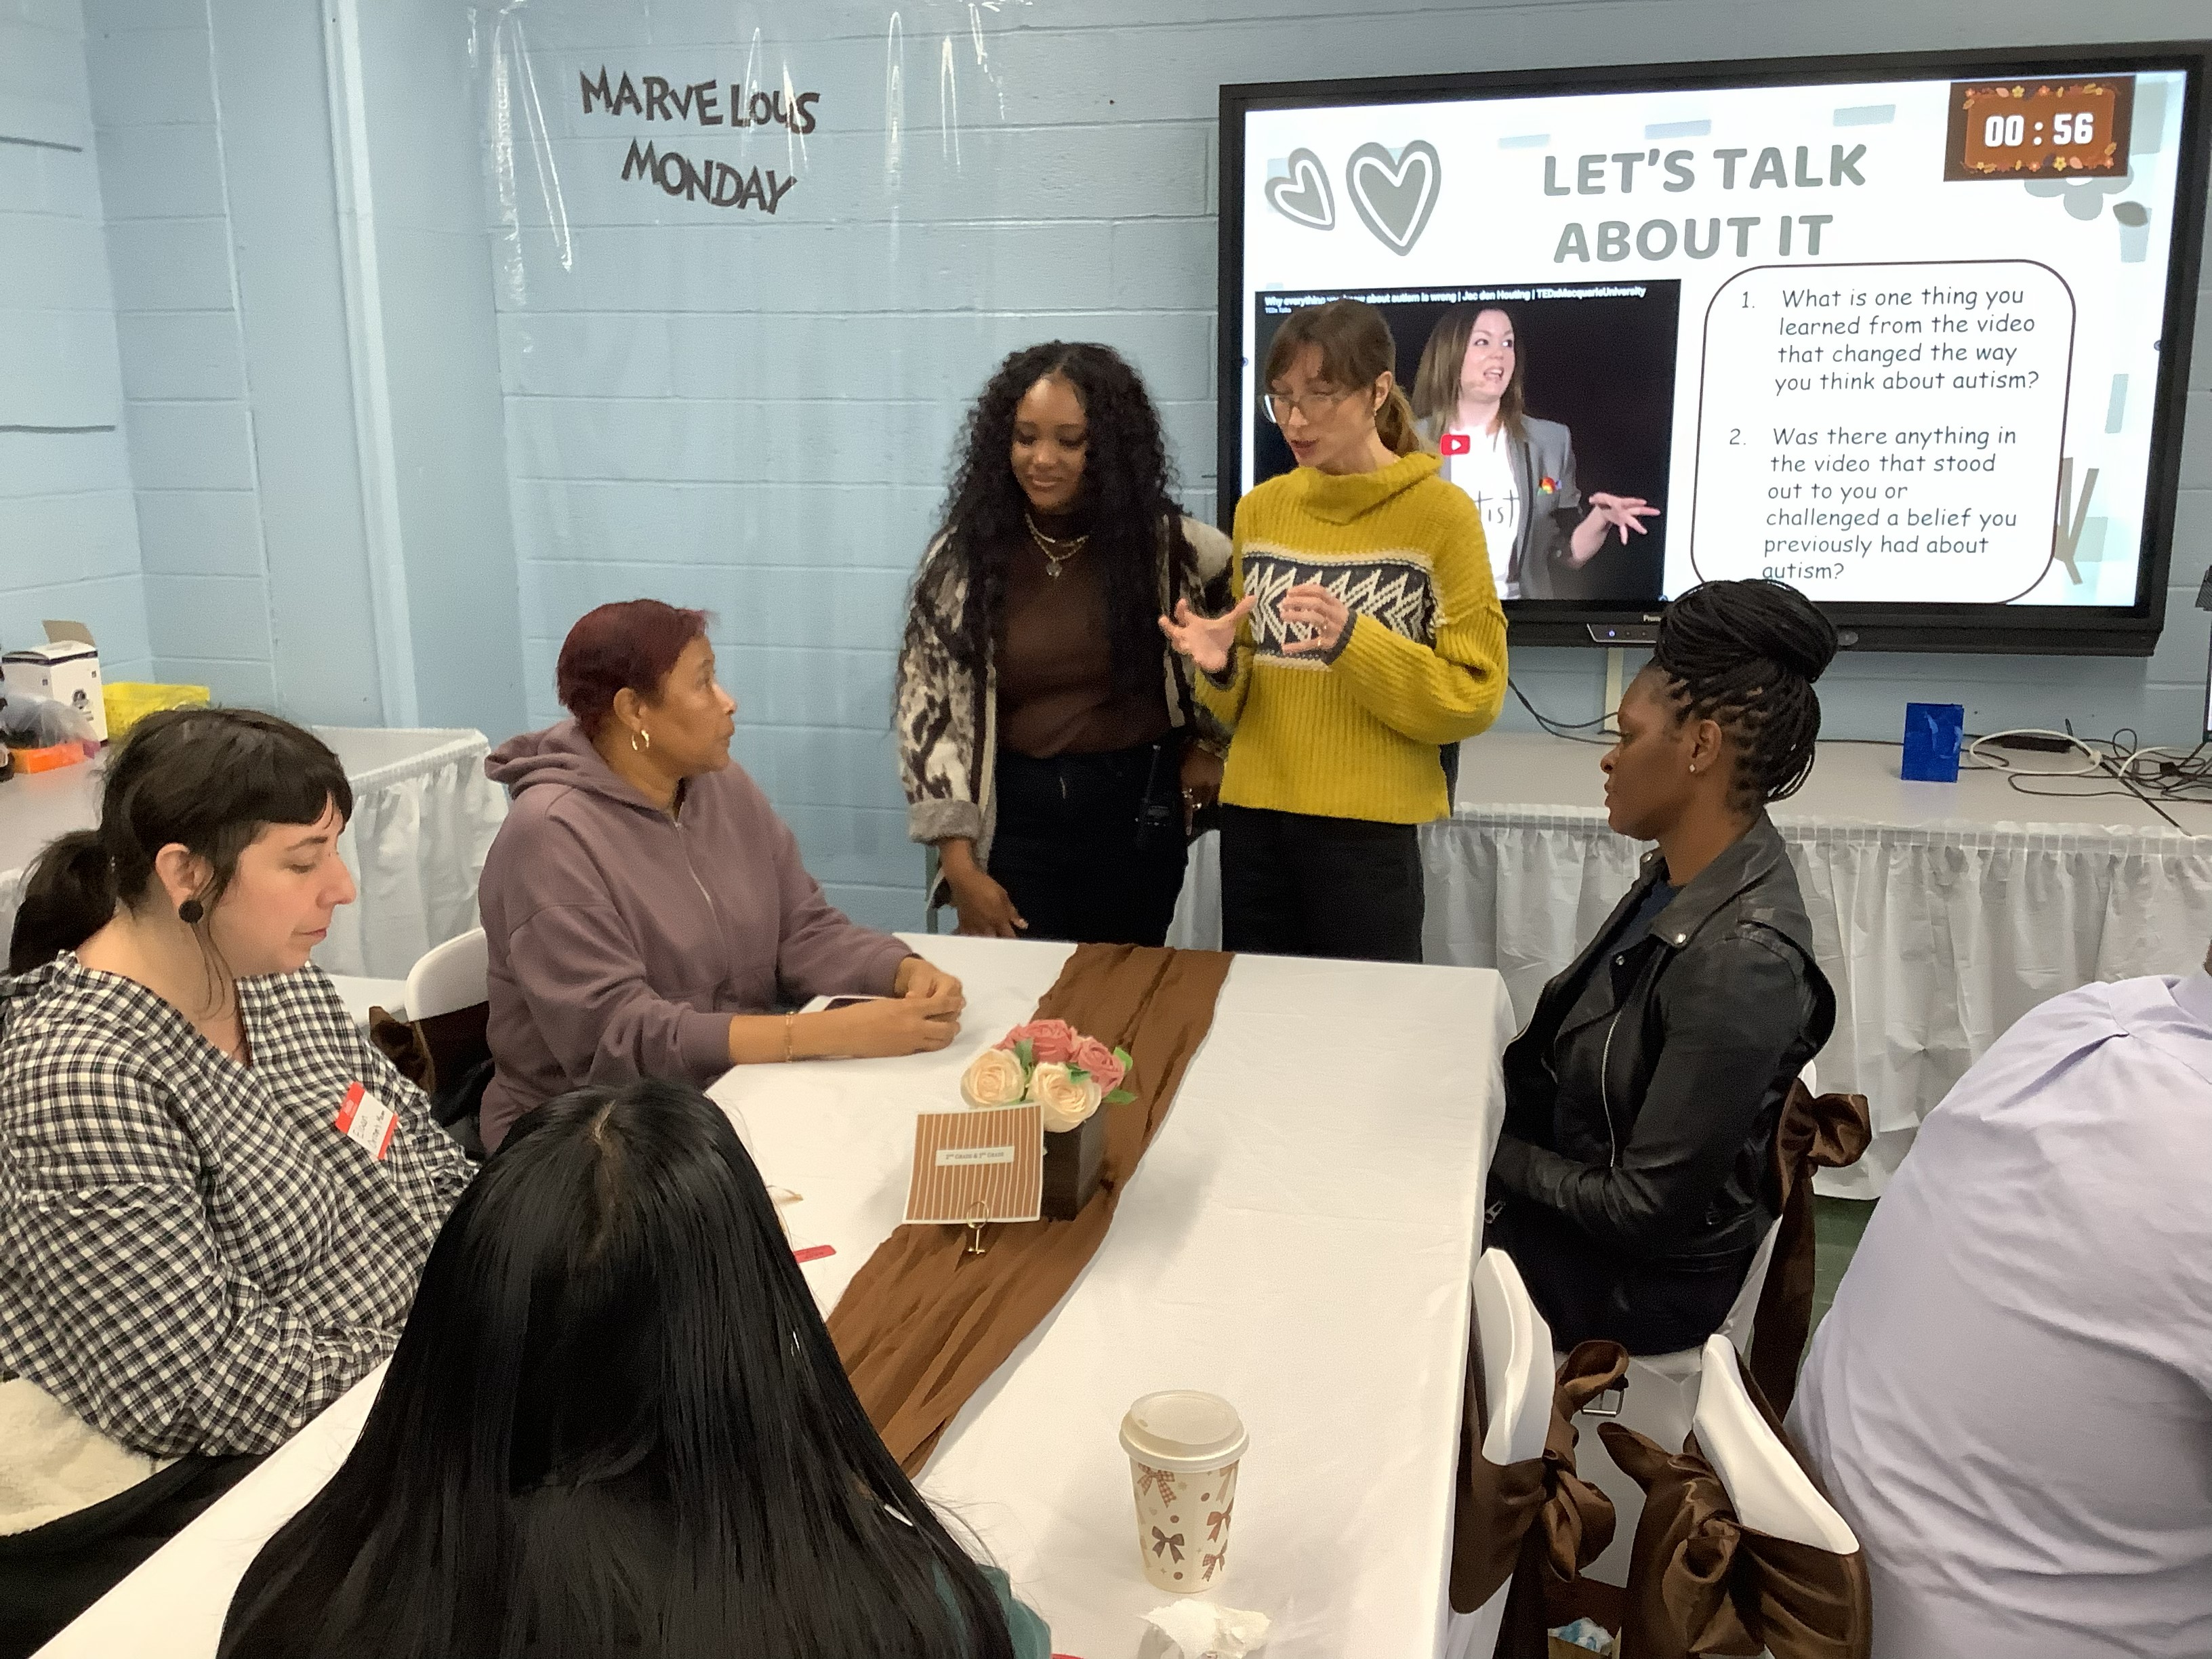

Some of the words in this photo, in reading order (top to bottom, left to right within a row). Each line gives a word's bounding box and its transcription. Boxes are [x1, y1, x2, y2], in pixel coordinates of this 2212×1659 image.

[621, 138, 797, 214] MONDAY
[1544, 148, 1695, 196] LET'S
[1713, 144, 1866, 190] TALK
[1554, 217, 1765, 264] ABOUT
[1779, 215, 1833, 256] IT
[1265, 296, 1284, 308] Why
[1366, 293, 1390, 304] about
[1430, 293, 1456, 303] wrong
[1496, 289, 1531, 301] Houting
[1742, 291, 1755, 308] 1.
[1783, 289, 1841, 308] What
[1851, 289, 1866, 306] is
[1875, 293, 1912, 306] one
[1921, 286, 1978, 310] thing
[1986, 291, 2023, 310] you
[1780, 316, 1860, 335] learned
[1869, 315, 1921, 335] from
[1931, 314, 1968, 333] the
[1978, 313, 2034, 332] video
[1778, 345, 1824, 363] that
[1832, 343, 1922, 367] changed
[1931, 342, 1967, 361] the
[1977, 348, 2017, 366] way
[1776, 378, 1811, 396] you
[1820, 372, 1875, 390] think
[1883, 371, 1945, 389] about
[1953, 371, 2039, 388] autism?
[1729, 428, 1746, 445] 2.
[1774, 428, 1818, 445] Was
[1827, 426, 1887, 445] there
[1896, 426, 1989, 450] anything
[1999, 426, 2015, 444] in
[1771, 455, 1805, 472] the
[1815, 454, 1869, 472] video
[1879, 453, 1926, 472] that
[1933, 453, 1996, 472] stood
[1768, 483, 1802, 499] out
[1811, 483, 1832, 499] to
[1841, 487, 1877, 504] you
[1885, 487, 1908, 499] or
[1767, 508, 1879, 531] challenged
[1887, 514, 1898, 526] a
[1908, 508, 1971, 527] belief
[1980, 514, 2016, 531] you
[1765, 535, 1872, 558] previously
[1881, 535, 1919, 552] had
[1927, 535, 1989, 553] about
[1762, 562, 1844, 579] autism?
